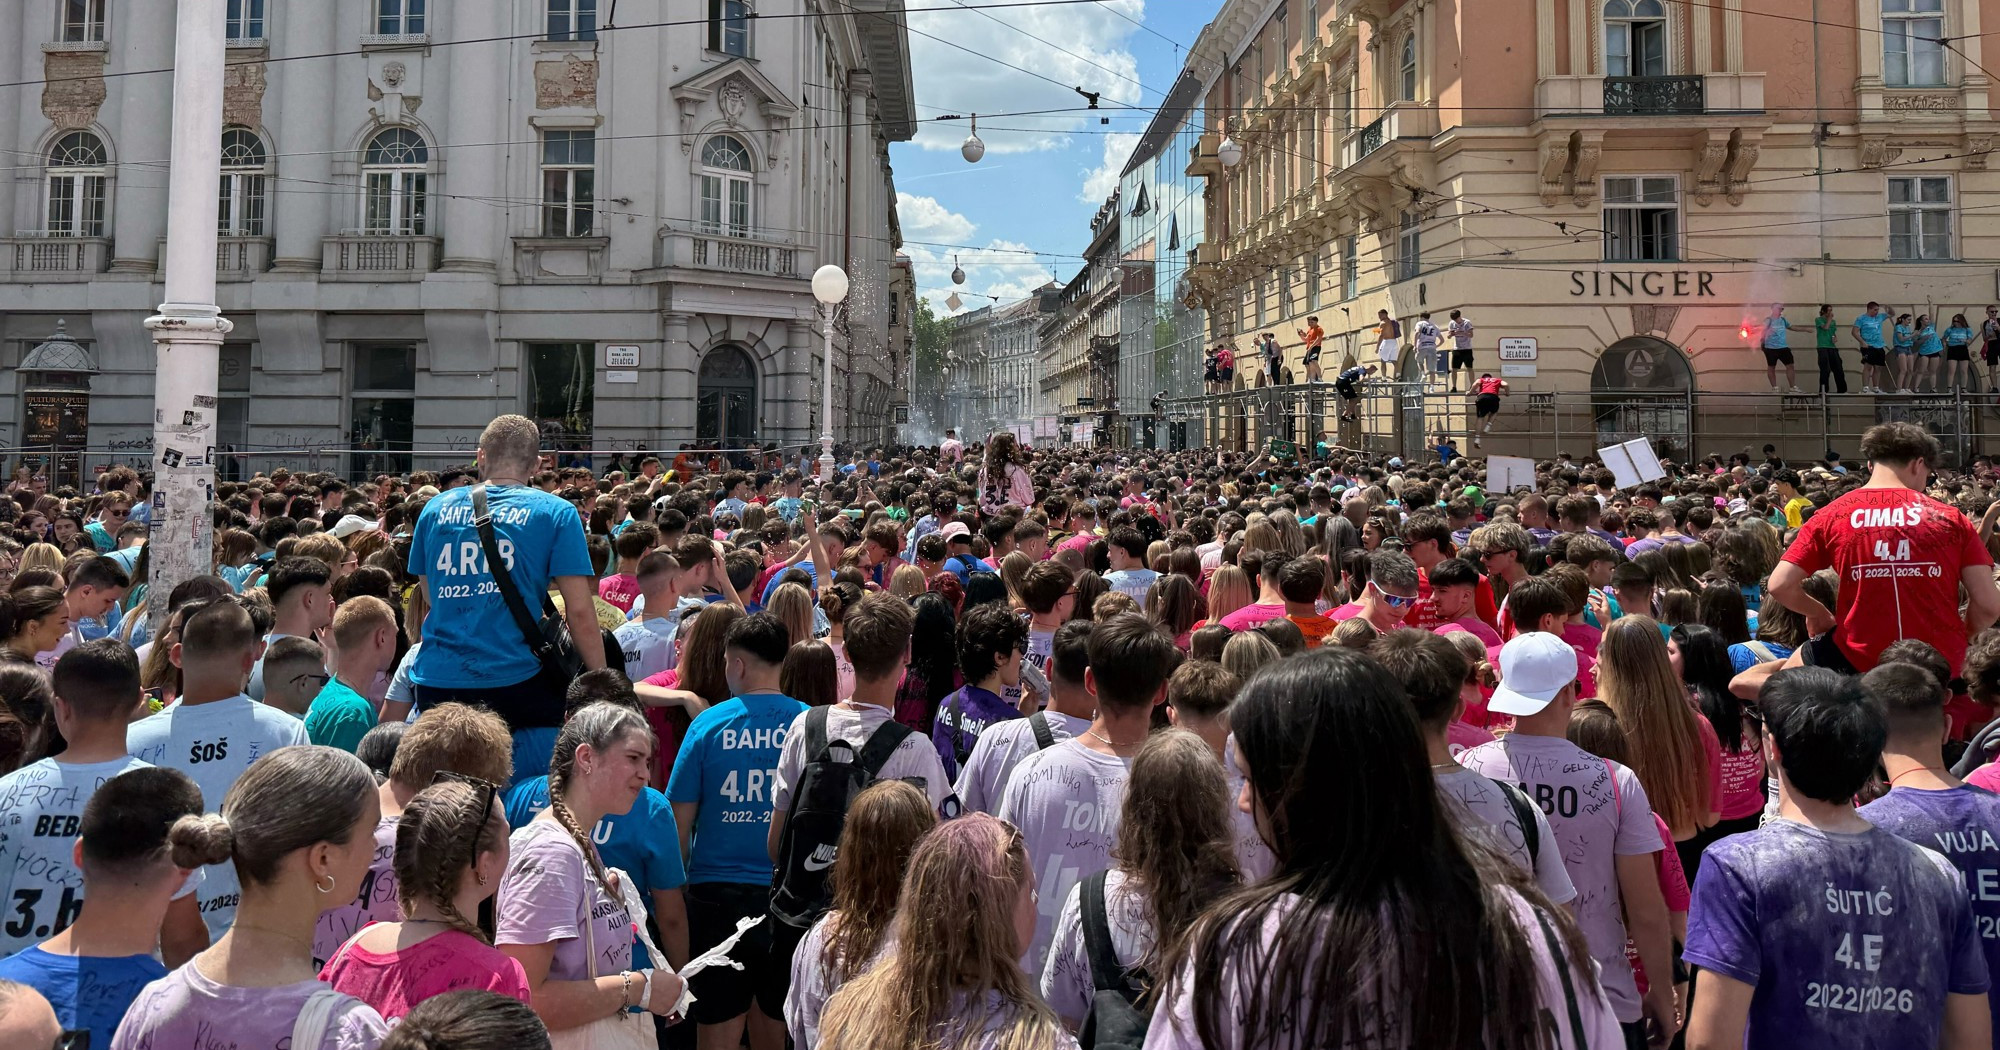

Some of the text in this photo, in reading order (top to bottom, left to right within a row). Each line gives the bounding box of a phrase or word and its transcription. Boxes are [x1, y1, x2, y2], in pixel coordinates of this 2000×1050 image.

[1570, 271, 1716, 296] SINGER
[505, 508, 532, 526] DCI
[1850, 502, 1922, 529] CIMAŠ
[1873, 538, 1911, 561] 4.A
[1865, 567, 1892, 578] 2022.
[1896, 567, 1924, 577] 2026.
[1928, 566, 1942, 578] (4)
[960, 712, 986, 738] Smeli
[189, 737, 228, 764] ŠOŠ
[1, 784, 79, 812] BERTA
[1825, 881, 1893, 916] ŠUTIĆ
[1834, 932, 1884, 971] 4.E
[1805, 981, 1914, 1013] 2022/2026
